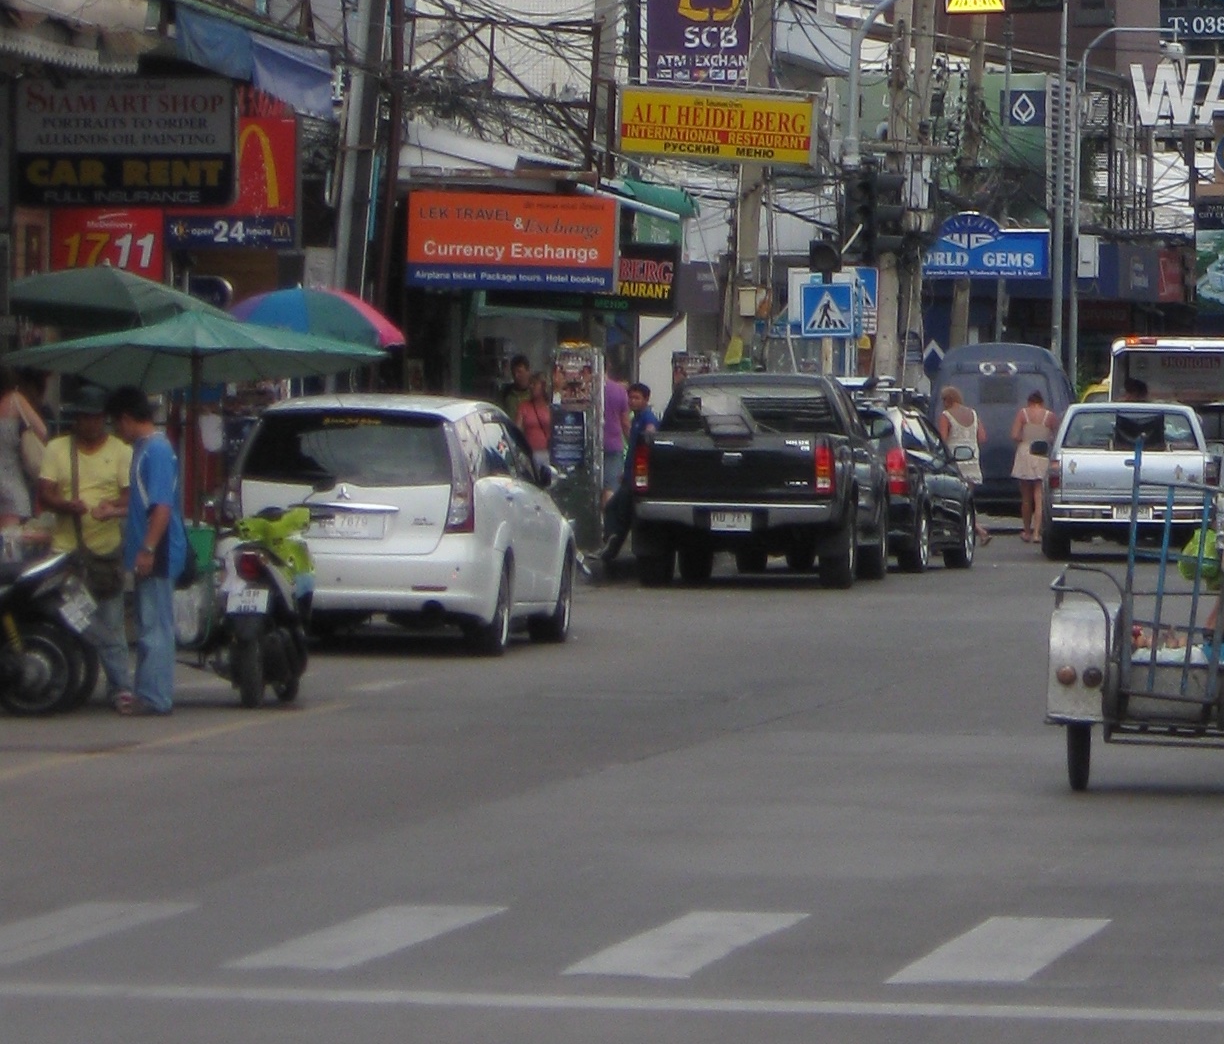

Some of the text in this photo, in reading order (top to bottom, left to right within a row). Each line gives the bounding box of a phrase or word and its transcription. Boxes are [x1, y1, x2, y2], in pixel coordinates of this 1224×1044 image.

[684, 26, 738, 49] SCB
[656, 55, 687, 67] ATM
[26, 82, 97, 113] SIAM
[106, 94, 152, 113] ART
[157, 94, 224, 113] SHOP
[42, 117, 208, 129] PORTRAITS TO ORDER
[631, 103, 807, 134] ALT HEIDELBERG
[112, 133, 135, 145] OIL
[141, 133, 216, 145] PAINTING
[626, 124, 808, 151] INTERNATIONAL RESTAURANT
[663, 142, 775, 159] РУССКИЙ МЕНЮ
[26, 158, 224, 187] CAR RENT
[44, 190, 200, 203] FULL INSURANCE
[191, 220, 272, 243] open 24 hours
[419, 207, 602, 240] LEK TRAVEL & Exchange
[424, 240, 599, 264] Currency Exchange
[982, 252, 1035, 268] GEMS
[415, 270, 450, 281] Airplane
[452, 271, 476, 281] ticket
[481, 272, 517, 283] Package
[546, 274, 569, 284] Hotel
[570, 275, 605, 287] booking
[619, 259, 674, 284] BERG
